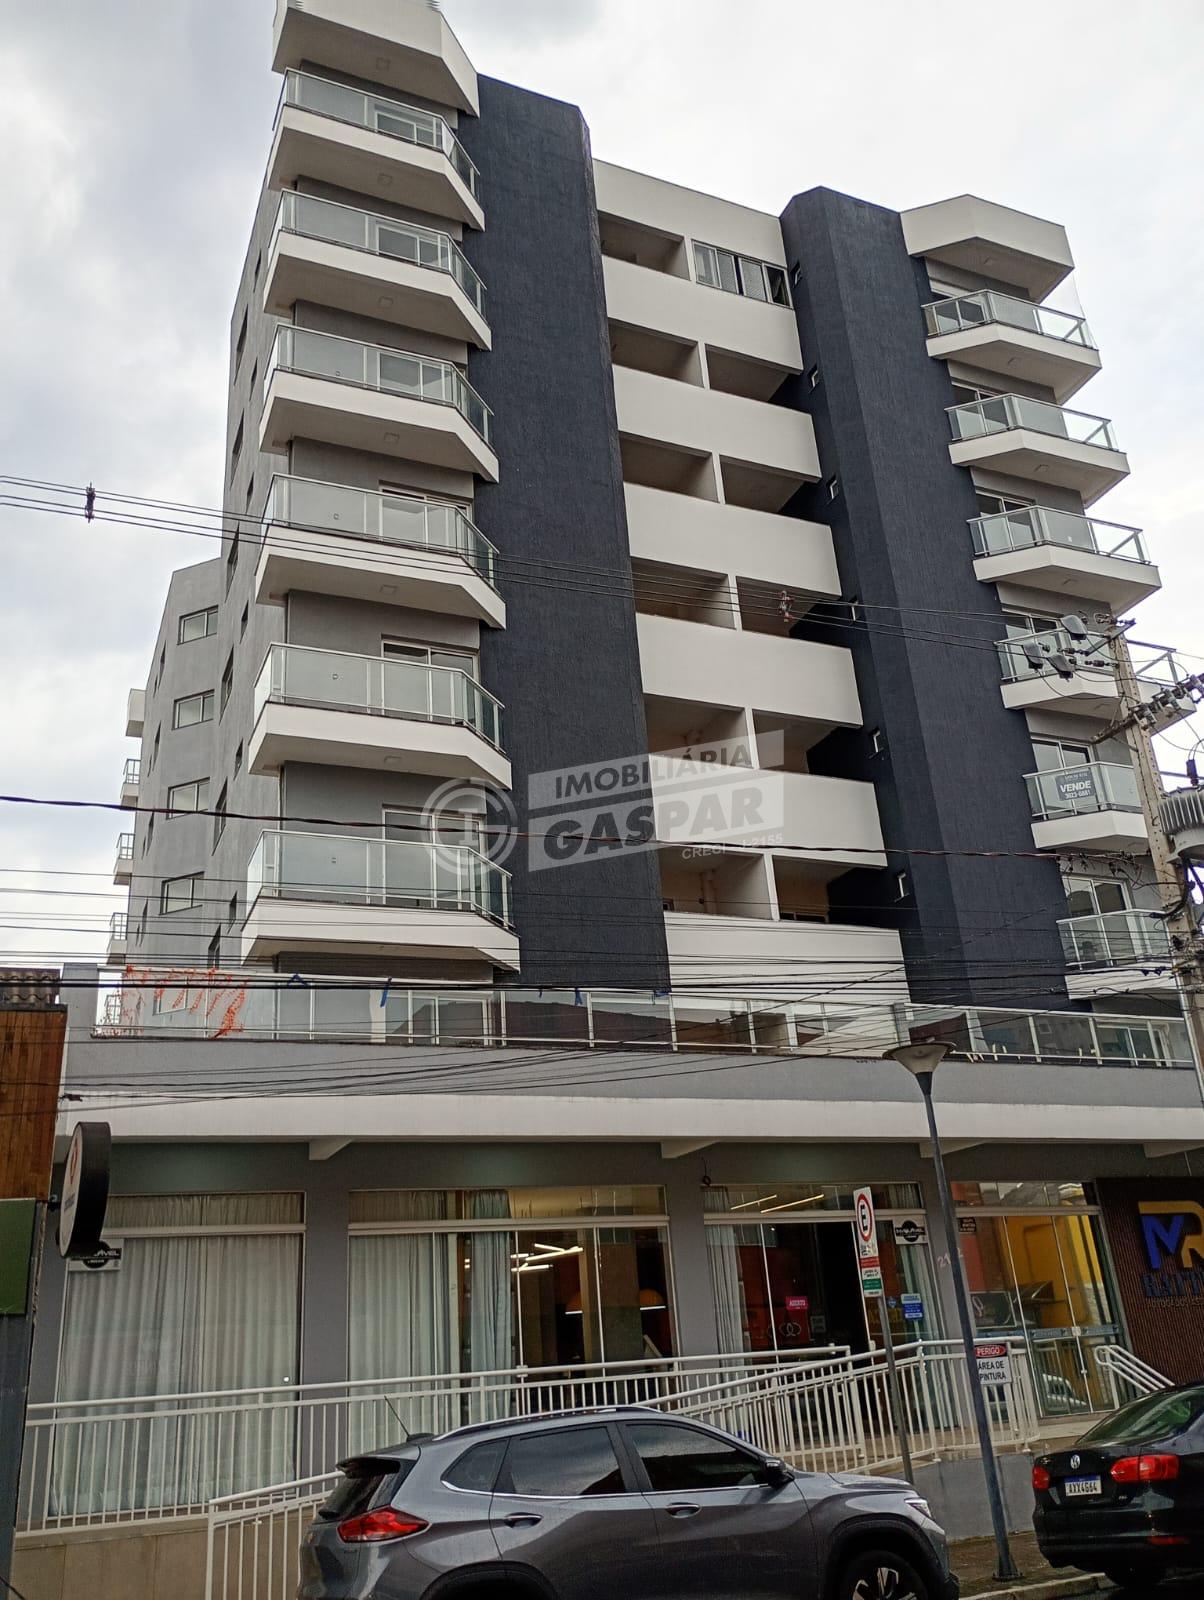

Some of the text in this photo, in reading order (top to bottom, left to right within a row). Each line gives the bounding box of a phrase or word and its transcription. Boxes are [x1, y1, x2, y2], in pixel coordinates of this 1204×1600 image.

[1060, 780, 1091, 793] VENDE
[975, 1347, 1000, 1356] PERIGO
[995, 1360, 1005, 1369] DE
[979, 1371, 1007, 1381] PINTURA
